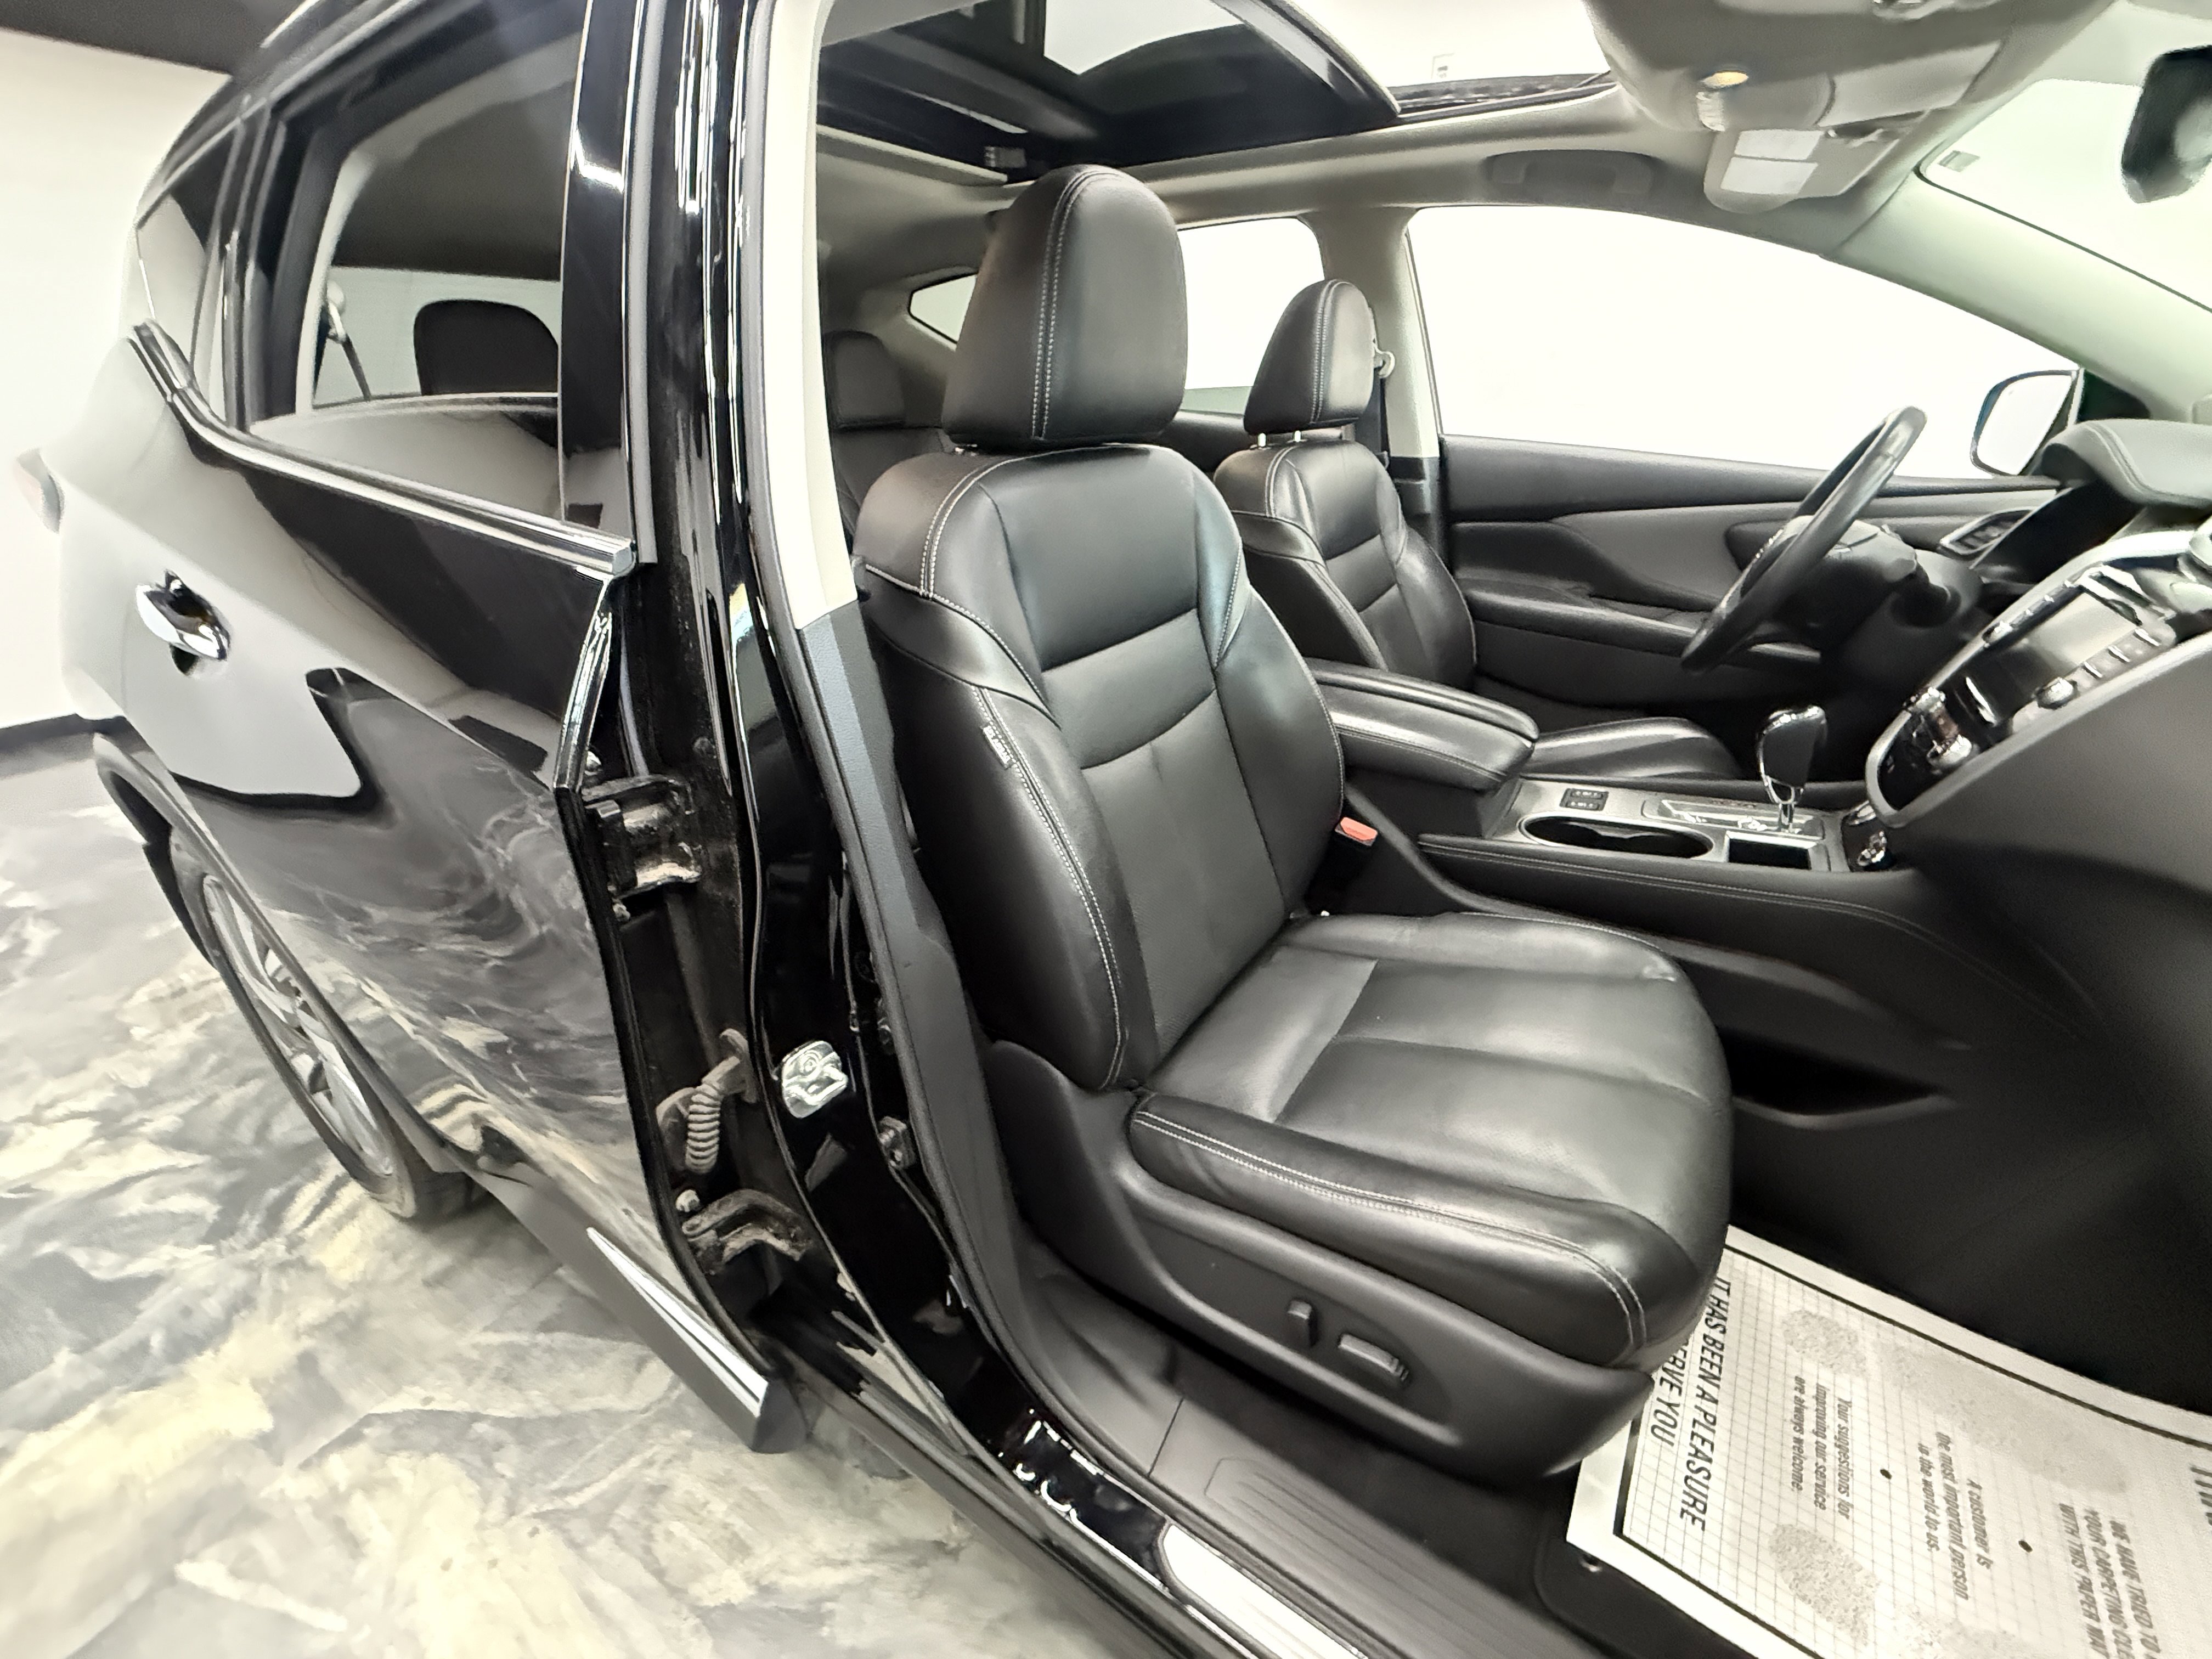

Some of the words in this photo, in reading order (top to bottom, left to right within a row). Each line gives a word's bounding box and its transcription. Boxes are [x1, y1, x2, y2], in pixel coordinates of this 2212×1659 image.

[1716, 1277, 1731, 1297] IT
[1705, 1295, 1729, 1334] HAS
[1659, 1339, 1689, 1397] RVE
[1698, 1333, 1725, 1389] BEEN
[1695, 1385, 1719, 1406] A
[1794, 1376, 1805, 1394] are
[1650, 1396, 1680, 1447] YOU
[1791, 1395, 1808, 1435] always
[1837, 1397, 1852, 1423] Your
[1815, 1440, 1827, 1463] our
[1834, 1424, 1854, 1497] suggestions
[1936, 1431, 1952, 1452] the
[1679, 1404, 1718, 1532] PLEASURE
[1919, 1456, 1934, 1477] the
[1939, 1453, 1958, 1484] most
[1967, 1479, 1982, 1490] A
[1814, 1462, 1830, 1510] service
[1922, 1479, 1940, 1517] world
[1838, 1498, 1854, 1519] for
[1925, 1515, 1940, 1531] to
[1943, 1483, 1967, 1549] important
[1968, 1490, 1989, 1554] customer
[2058, 1503, 2080, 1538] WITH
[1926, 1532, 1940, 1552] us.
[2084, 1509, 2107, 1547] YOUR
[2109, 1520, 2131, 1543] WE
[1948, 1546, 1968, 1600] person
[2067, 1539, 2090, 1573] THIS
[2115, 1544, 2141, 1583] HAVE
[2074, 1572, 2100, 1623] PAPER
[2091, 1547, 2128, 1629] CARPETING
[2125, 1583, 2153, 1629] TRIED
[2138, 1630, 2161, 1654] TO
